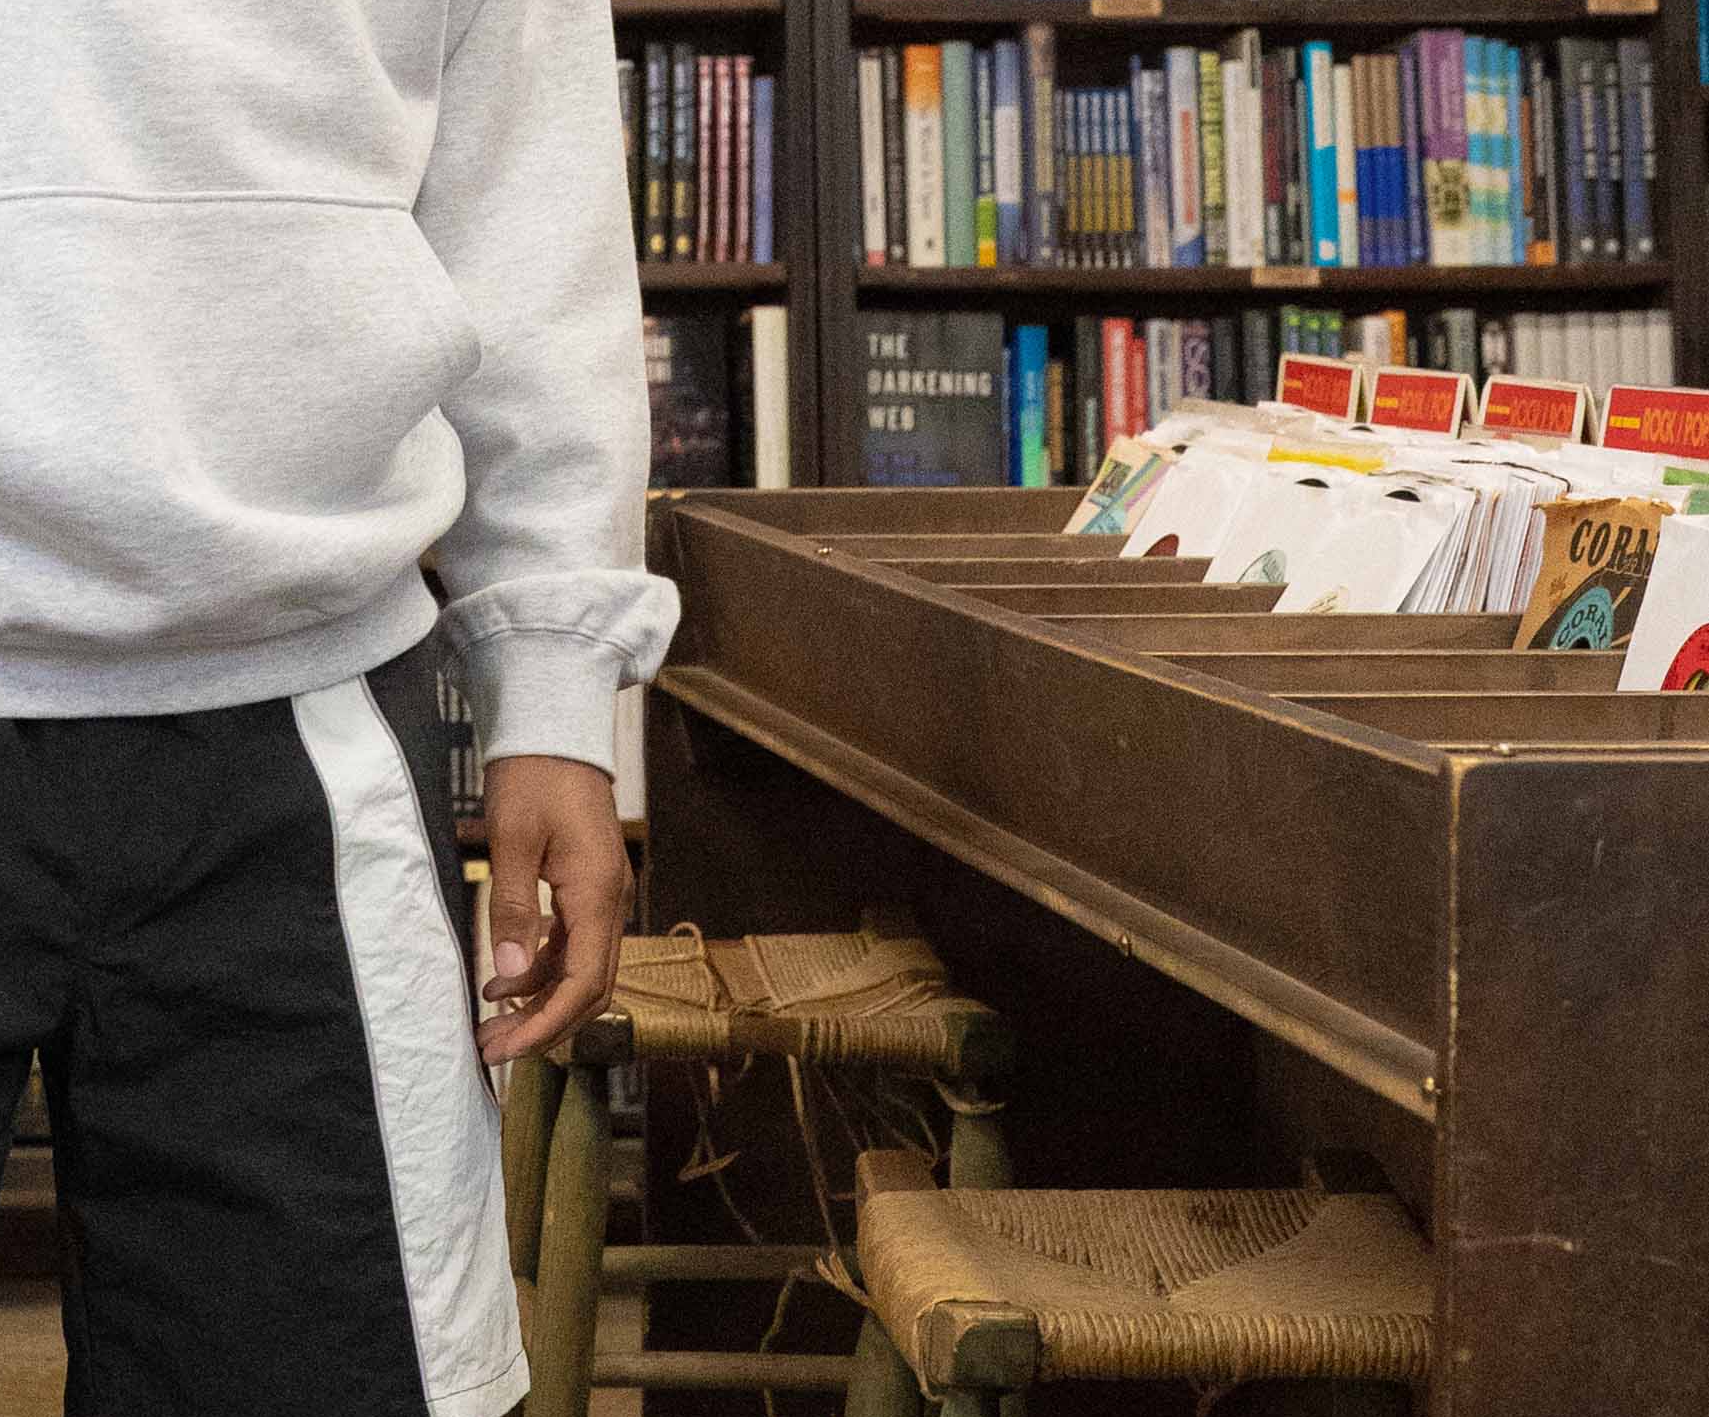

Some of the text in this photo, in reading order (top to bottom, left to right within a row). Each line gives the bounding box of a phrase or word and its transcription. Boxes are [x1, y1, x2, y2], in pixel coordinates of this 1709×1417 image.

[868, 333, 909, 359] THE
[867, 369, 992, 398] DARKENING
[867, 405, 915, 431] WEB
[1641, 406, 1676, 444] ROCK
[1570, 518, 1660, 572] CORA
